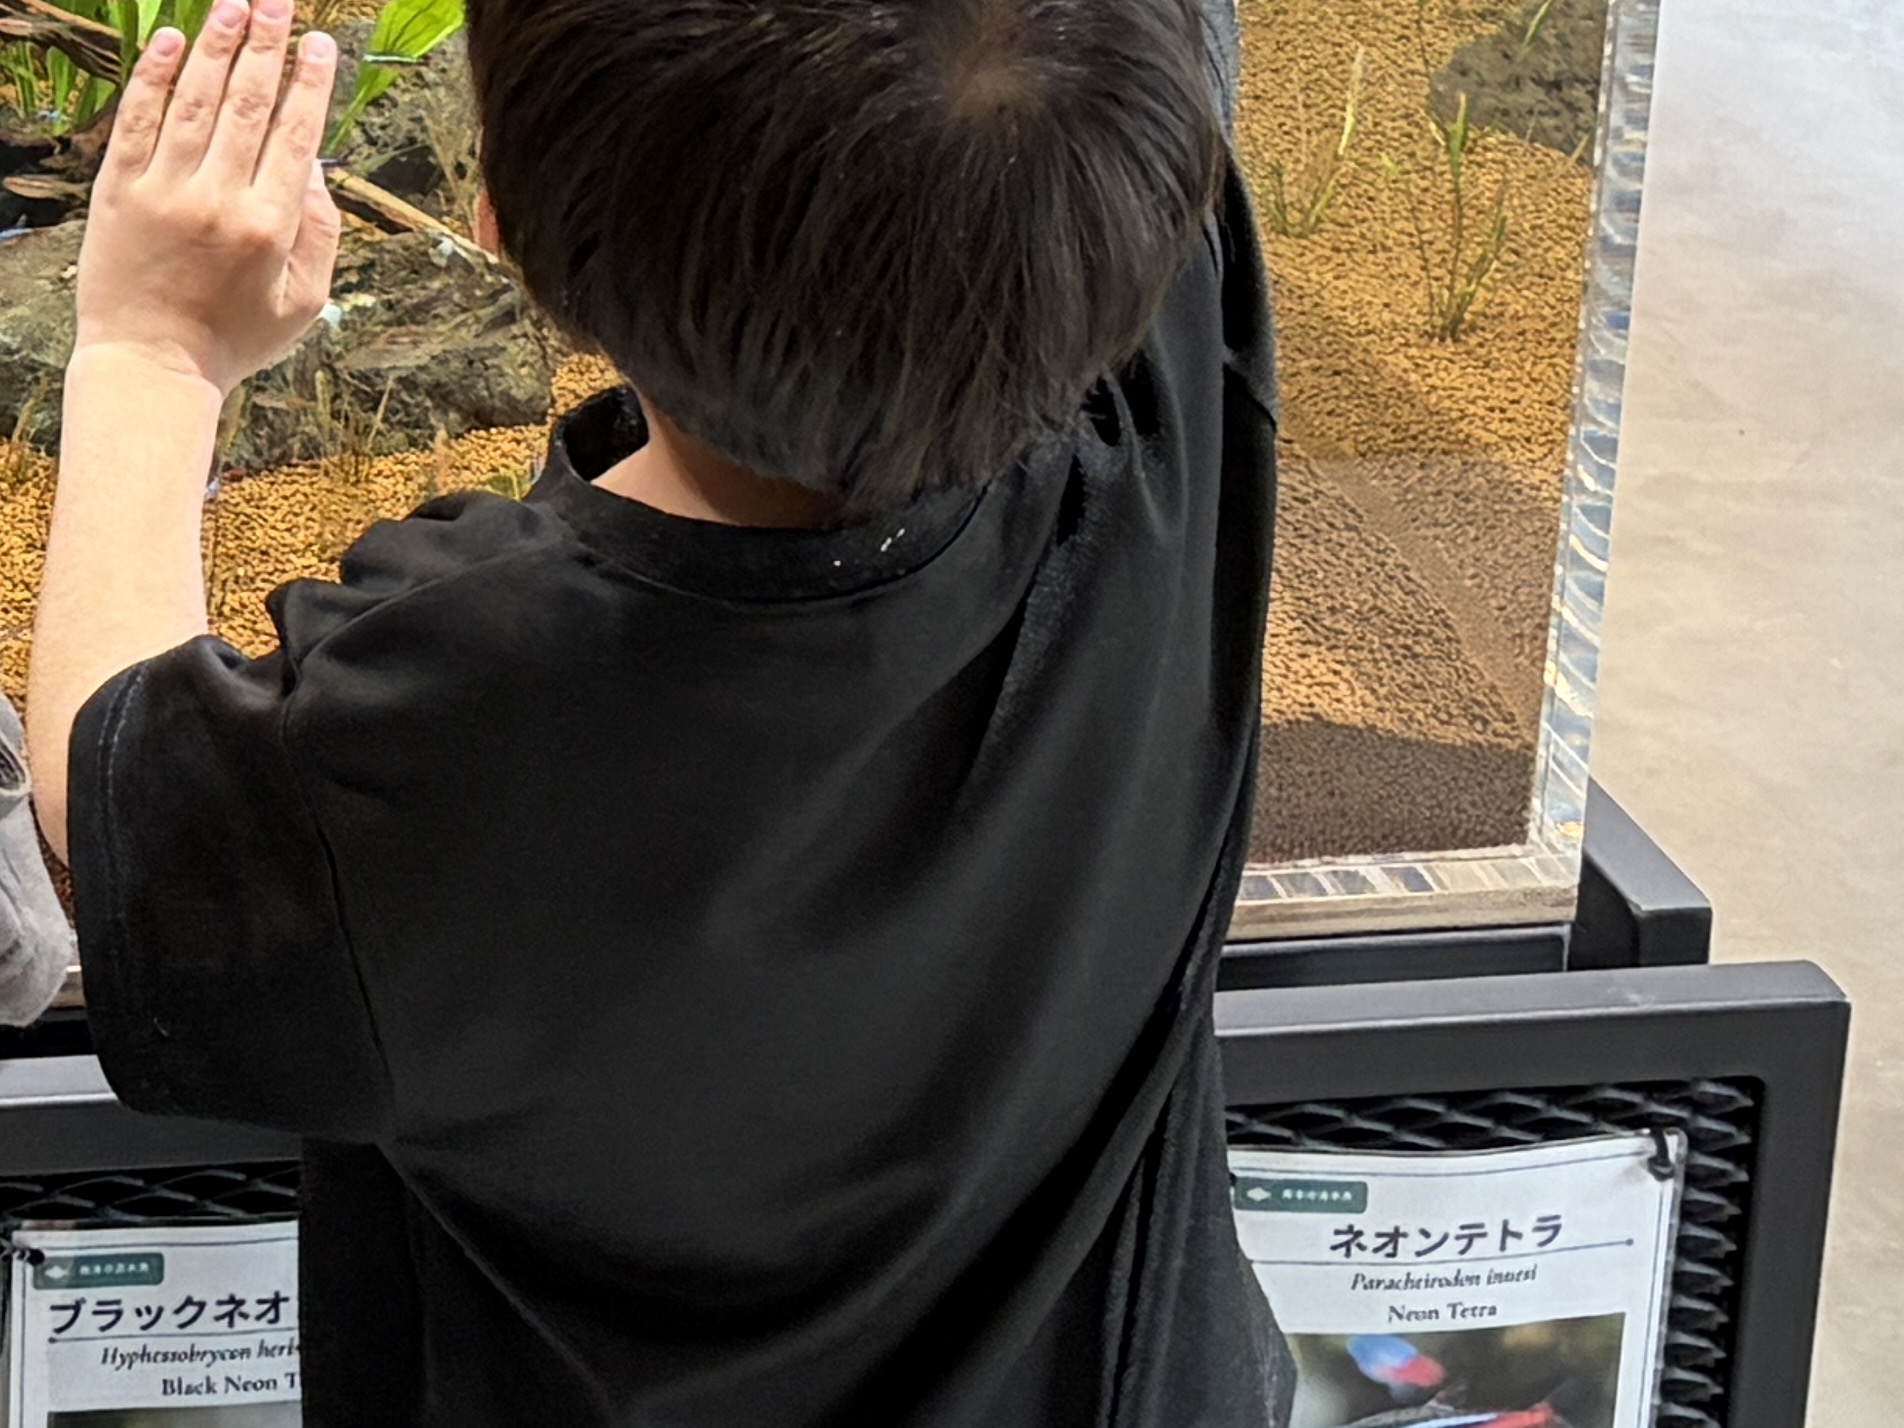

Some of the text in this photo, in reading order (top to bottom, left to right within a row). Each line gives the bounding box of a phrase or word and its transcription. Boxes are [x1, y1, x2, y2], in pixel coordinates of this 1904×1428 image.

[1329, 1214, 1562, 1259] ネオンテトラ
[49, 1290, 291, 1334] ブラックネオ
[1388, 1301, 1498, 1323] Neon Tetra
[161, 1376, 218, 1397] Black
[224, 1374, 278, 1393] Neon
